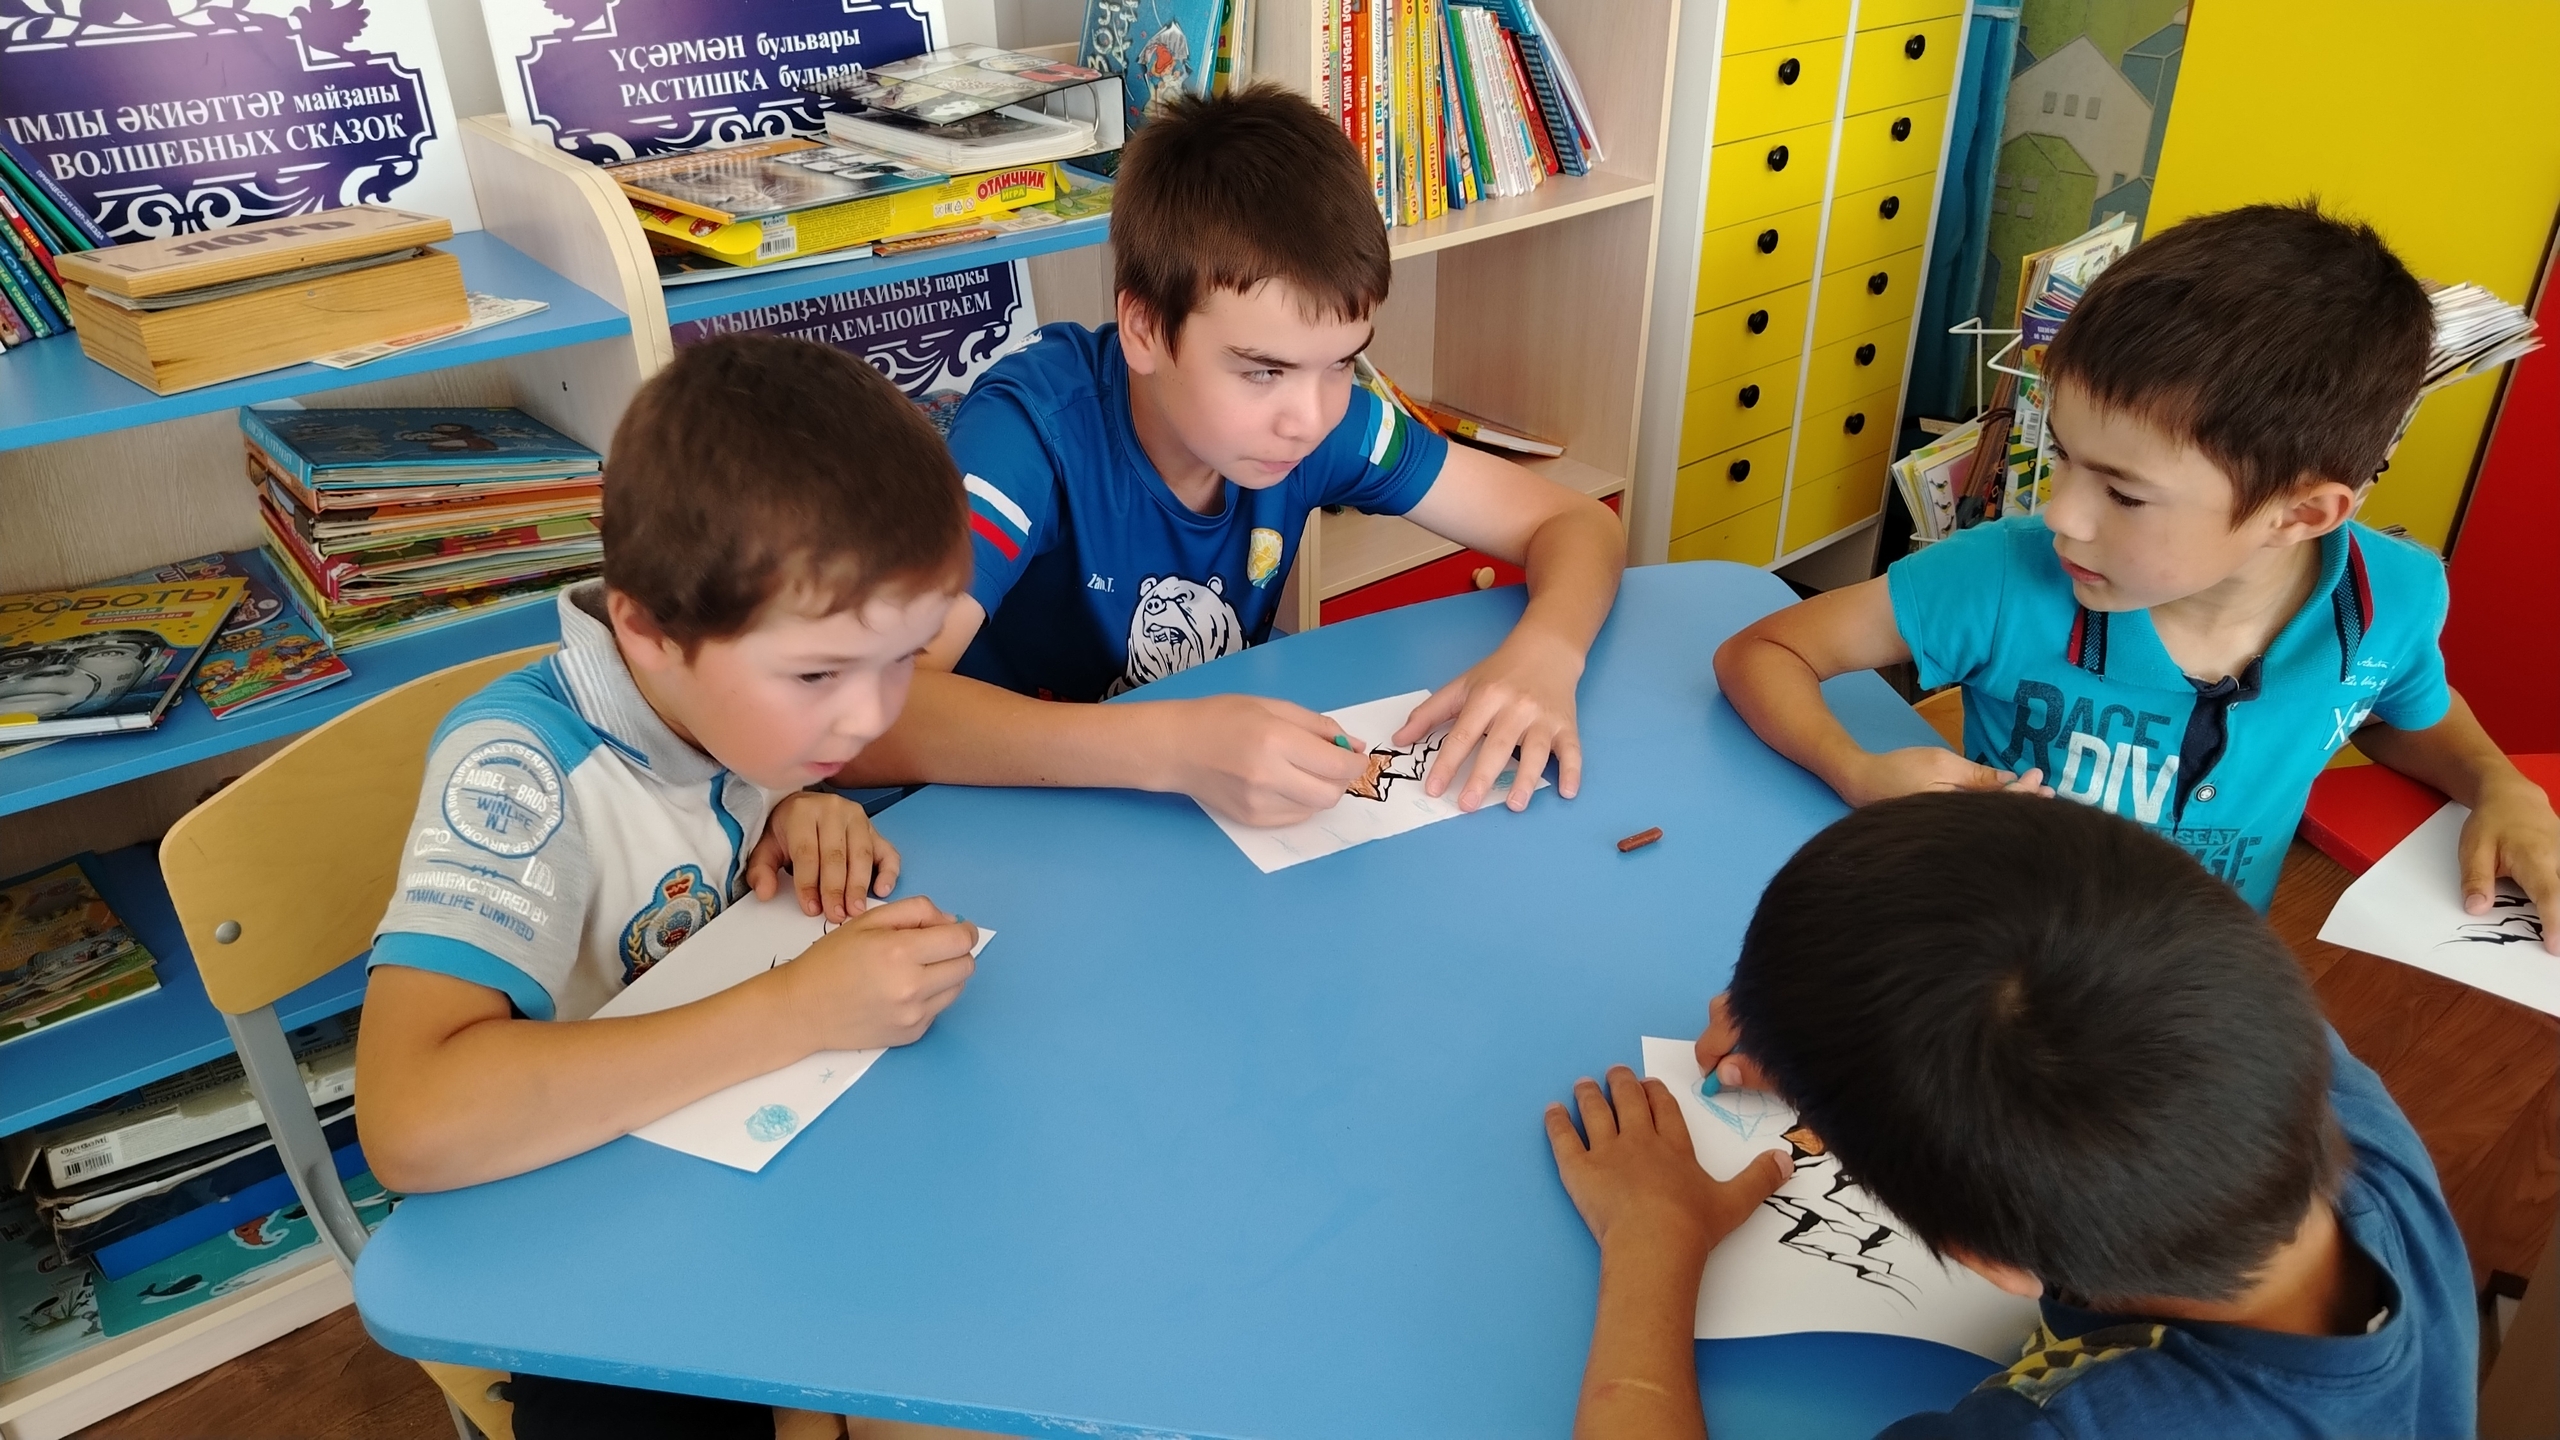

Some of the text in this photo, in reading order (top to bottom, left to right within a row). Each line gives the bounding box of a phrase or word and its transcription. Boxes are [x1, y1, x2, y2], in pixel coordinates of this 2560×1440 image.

[756, 28, 861, 61] бульвары
[1322, 30, 1330, 75] ПЕРВАЯ
[1342, 26, 1352, 72] ПЕРВАЯ
[619, 68, 769, 107] РАСТИШКА
[1342, 77, 1352, 111] КНИГА
[117, 90, 285, 133] ӘКИӘТТӘР
[1374, 84, 1384, 140] ДЕТСКАЯ
[48, 112, 408, 180] ВОЛШЕБНЫХ СКАЗОК
[976, 169, 1048, 201] ОТЛИЧНИК
[1001, 185, 1027, 201] ИГРА
[35, 169, 69, 205] ПРИНЦЕССА
[71, 206, 105, 241] ПОП-ЗВЕЗДА
[22, 227, 41, 248] цвета
[935, 267, 990, 293] паркы
[12, 285, 43, 330] ВАСИЛИСА
[0, 585, 230, 614] РОБОТЫ
[88, 613, 185, 625] ЭНЦИКЛОПЕДИЯ
[94, 608, 158, 618] БОЛЬШАЯ
[2002, 678, 2172, 787] RACE
[464, 768, 506, 792] AUDEL
[515, 783, 552, 813] BROS
